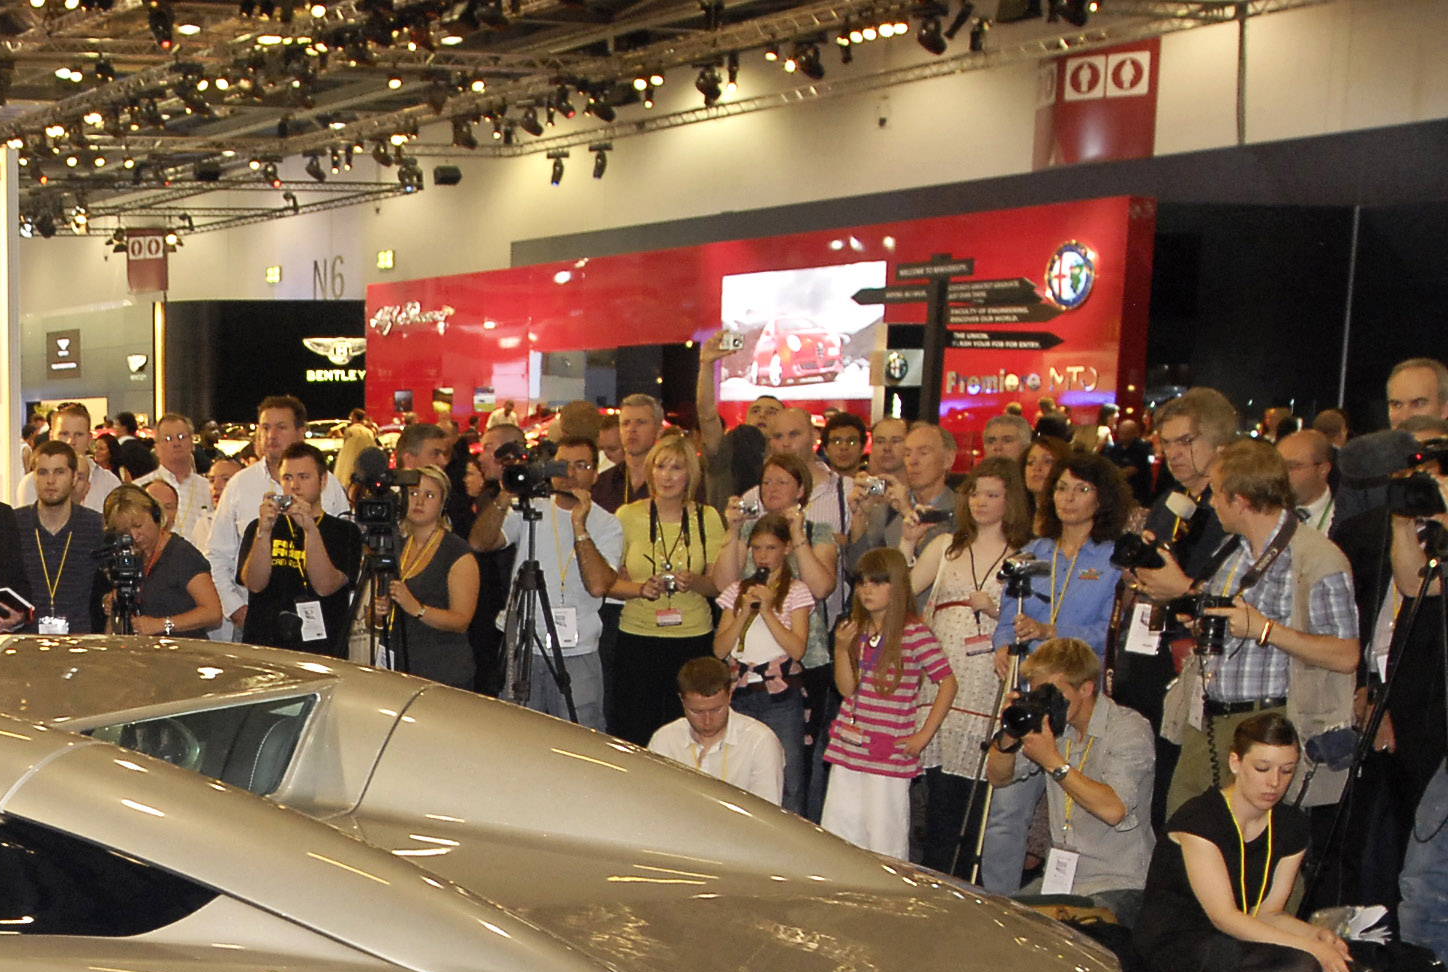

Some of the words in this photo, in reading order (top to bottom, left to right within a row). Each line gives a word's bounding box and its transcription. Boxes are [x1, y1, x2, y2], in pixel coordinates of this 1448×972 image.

[313, 255, 345, 300] N6
[306, 369, 367, 382] BENTLEY
[946, 368, 1041, 395] Premiere
